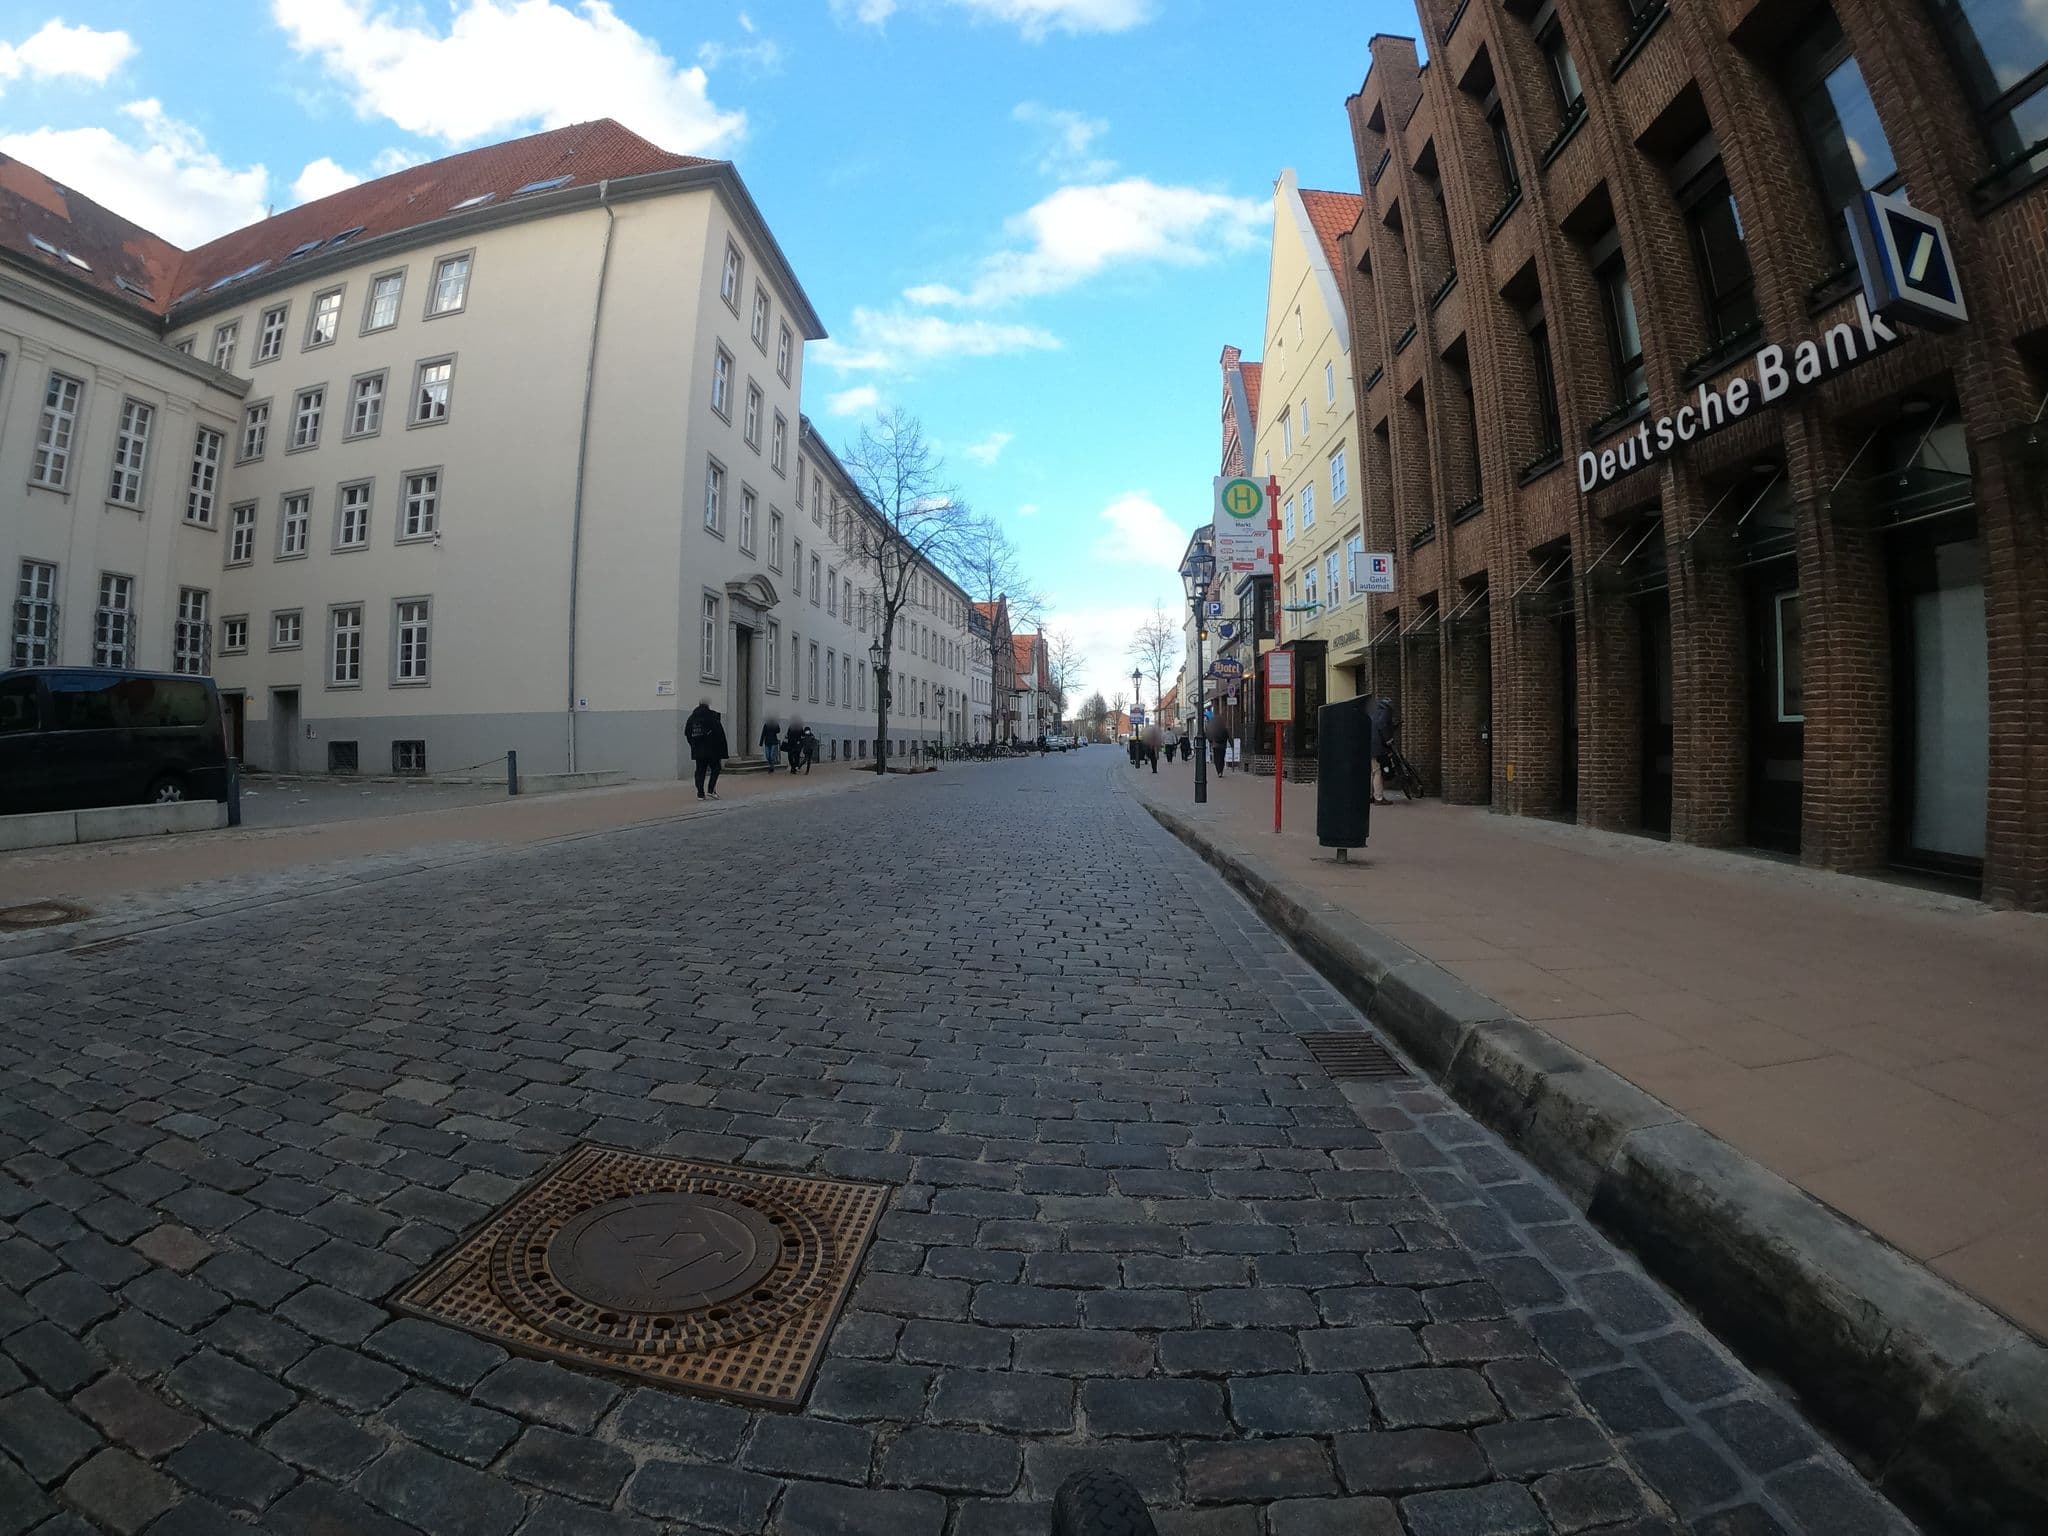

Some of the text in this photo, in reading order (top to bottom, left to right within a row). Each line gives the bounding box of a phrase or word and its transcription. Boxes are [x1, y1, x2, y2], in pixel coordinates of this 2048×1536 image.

[1577, 293, 1898, 493] Deutsche Bank
[1234, 488, 1251, 510] H
[1210, 603, 1220, 614] P
